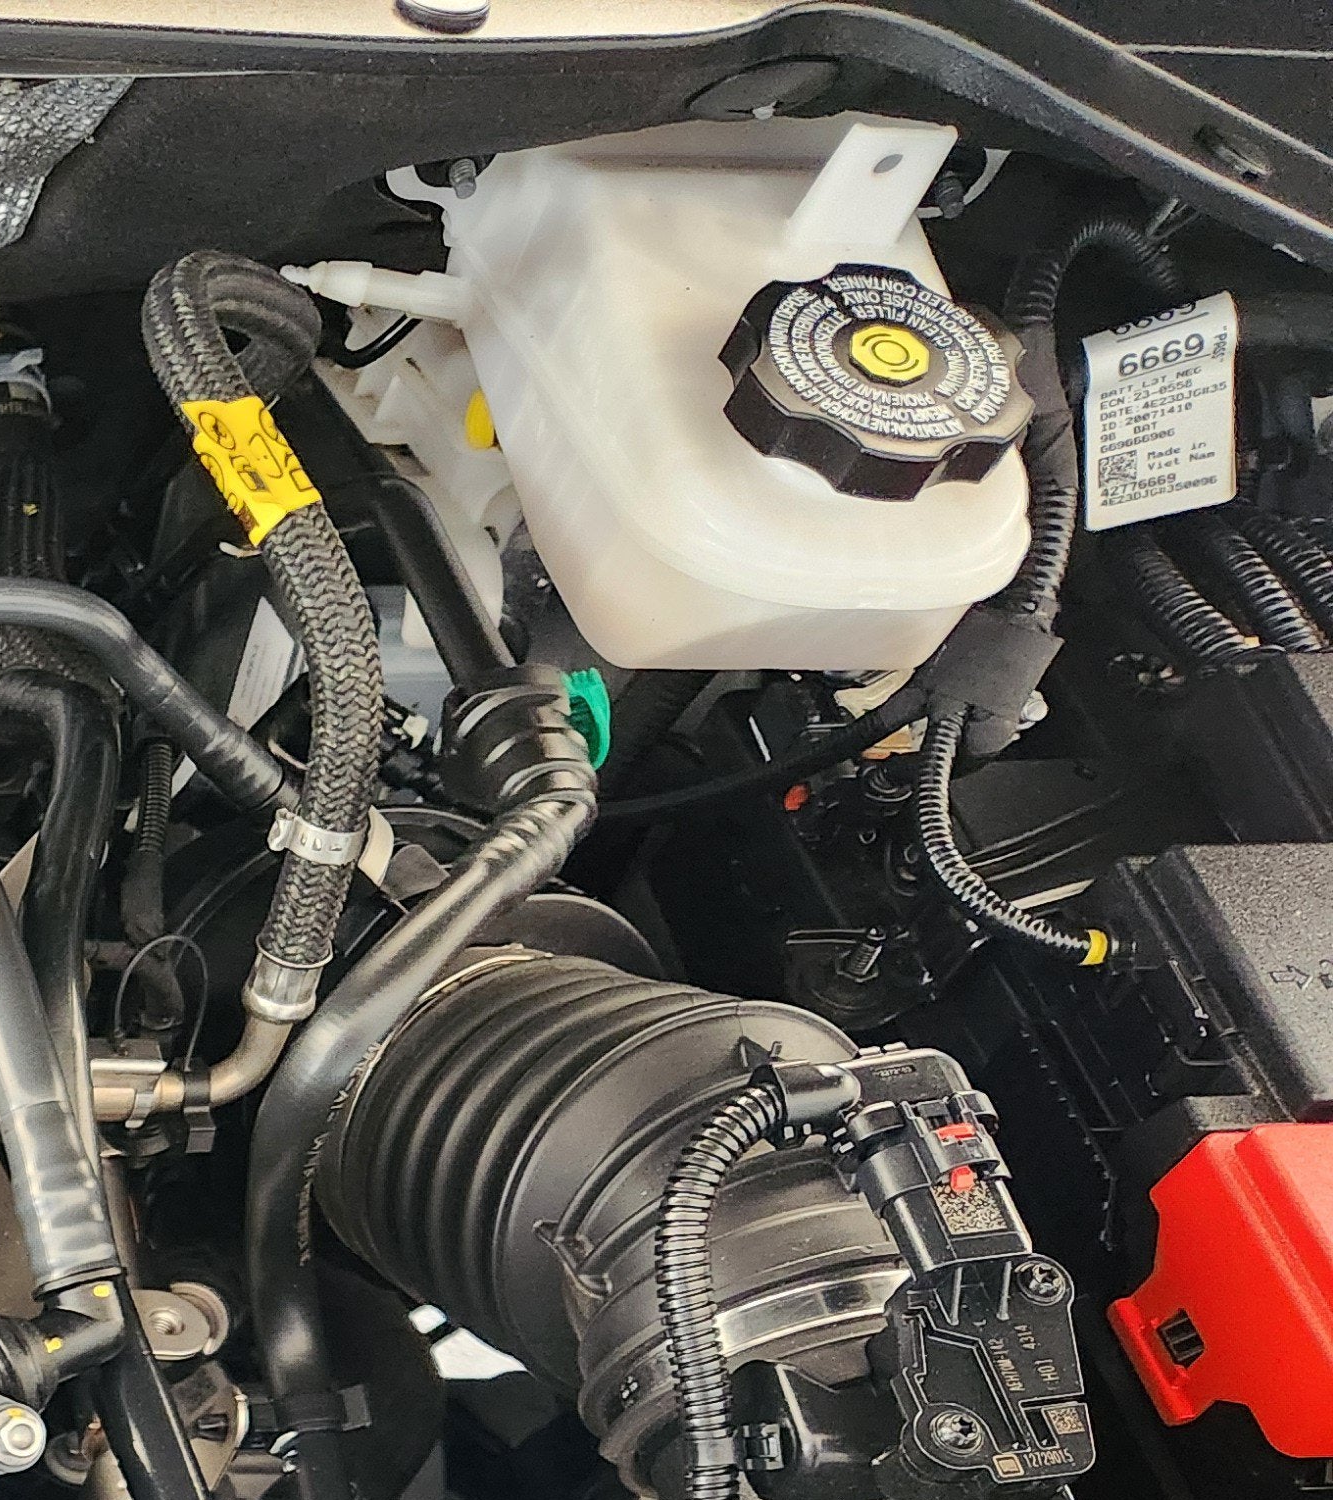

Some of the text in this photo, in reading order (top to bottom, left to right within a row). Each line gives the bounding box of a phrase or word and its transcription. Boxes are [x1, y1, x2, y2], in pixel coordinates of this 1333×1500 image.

[835, 290, 881, 306] ONLY
[881, 291, 914, 312] USE
[916, 287, 977, 326] SEALED
[849, 306, 907, 324] FILLER
[905, 314, 954, 348] CLEAN
[972, 330, 1007, 363] FROM
[1118, 333, 1204, 377] 6669
[1147, 447, 1181, 460] Made
[1148, 451, 1215, 470] Viet Nam
